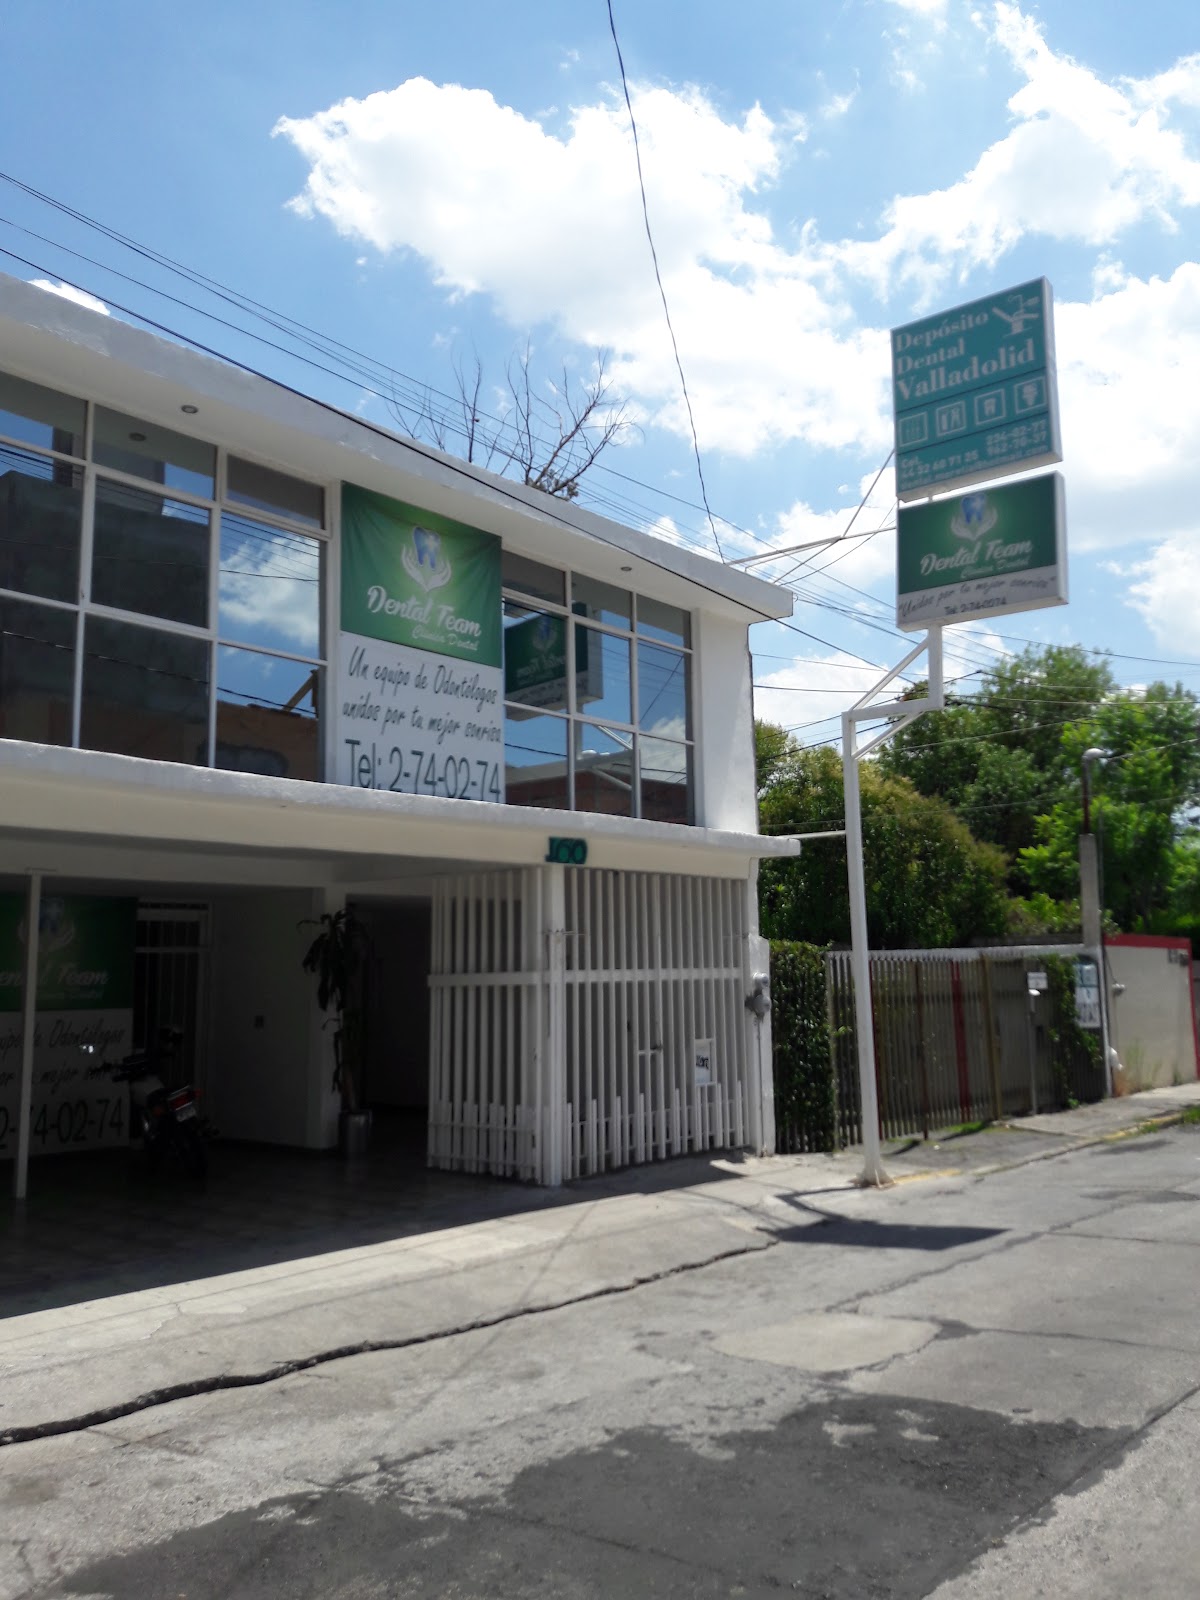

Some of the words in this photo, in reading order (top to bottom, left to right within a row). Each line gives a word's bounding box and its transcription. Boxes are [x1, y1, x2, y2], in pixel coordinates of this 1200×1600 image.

[896, 312, 989, 349] Depósito
[896, 338, 965, 374] Dental
[896, 339, 1036, 400] Valladolid
[920, 542, 981, 576] Dental
[985, 539, 1032, 561] Team
[367, 585, 433, 624] Dental
[437, 604, 481, 637] Team
[349, 646, 368, 680] Un
[374, 662, 410, 697] equipo
[414, 664, 428, 689] de
[342, 692, 381, 721] unidos
[381, 706, 406, 736] por
[411, 705, 424, 729] tu
[428, 712, 460, 745] mejor
[389, 747, 500, 803] 2-74-02-74
[0, 1097, 124, 1149] 2-4-02-74
